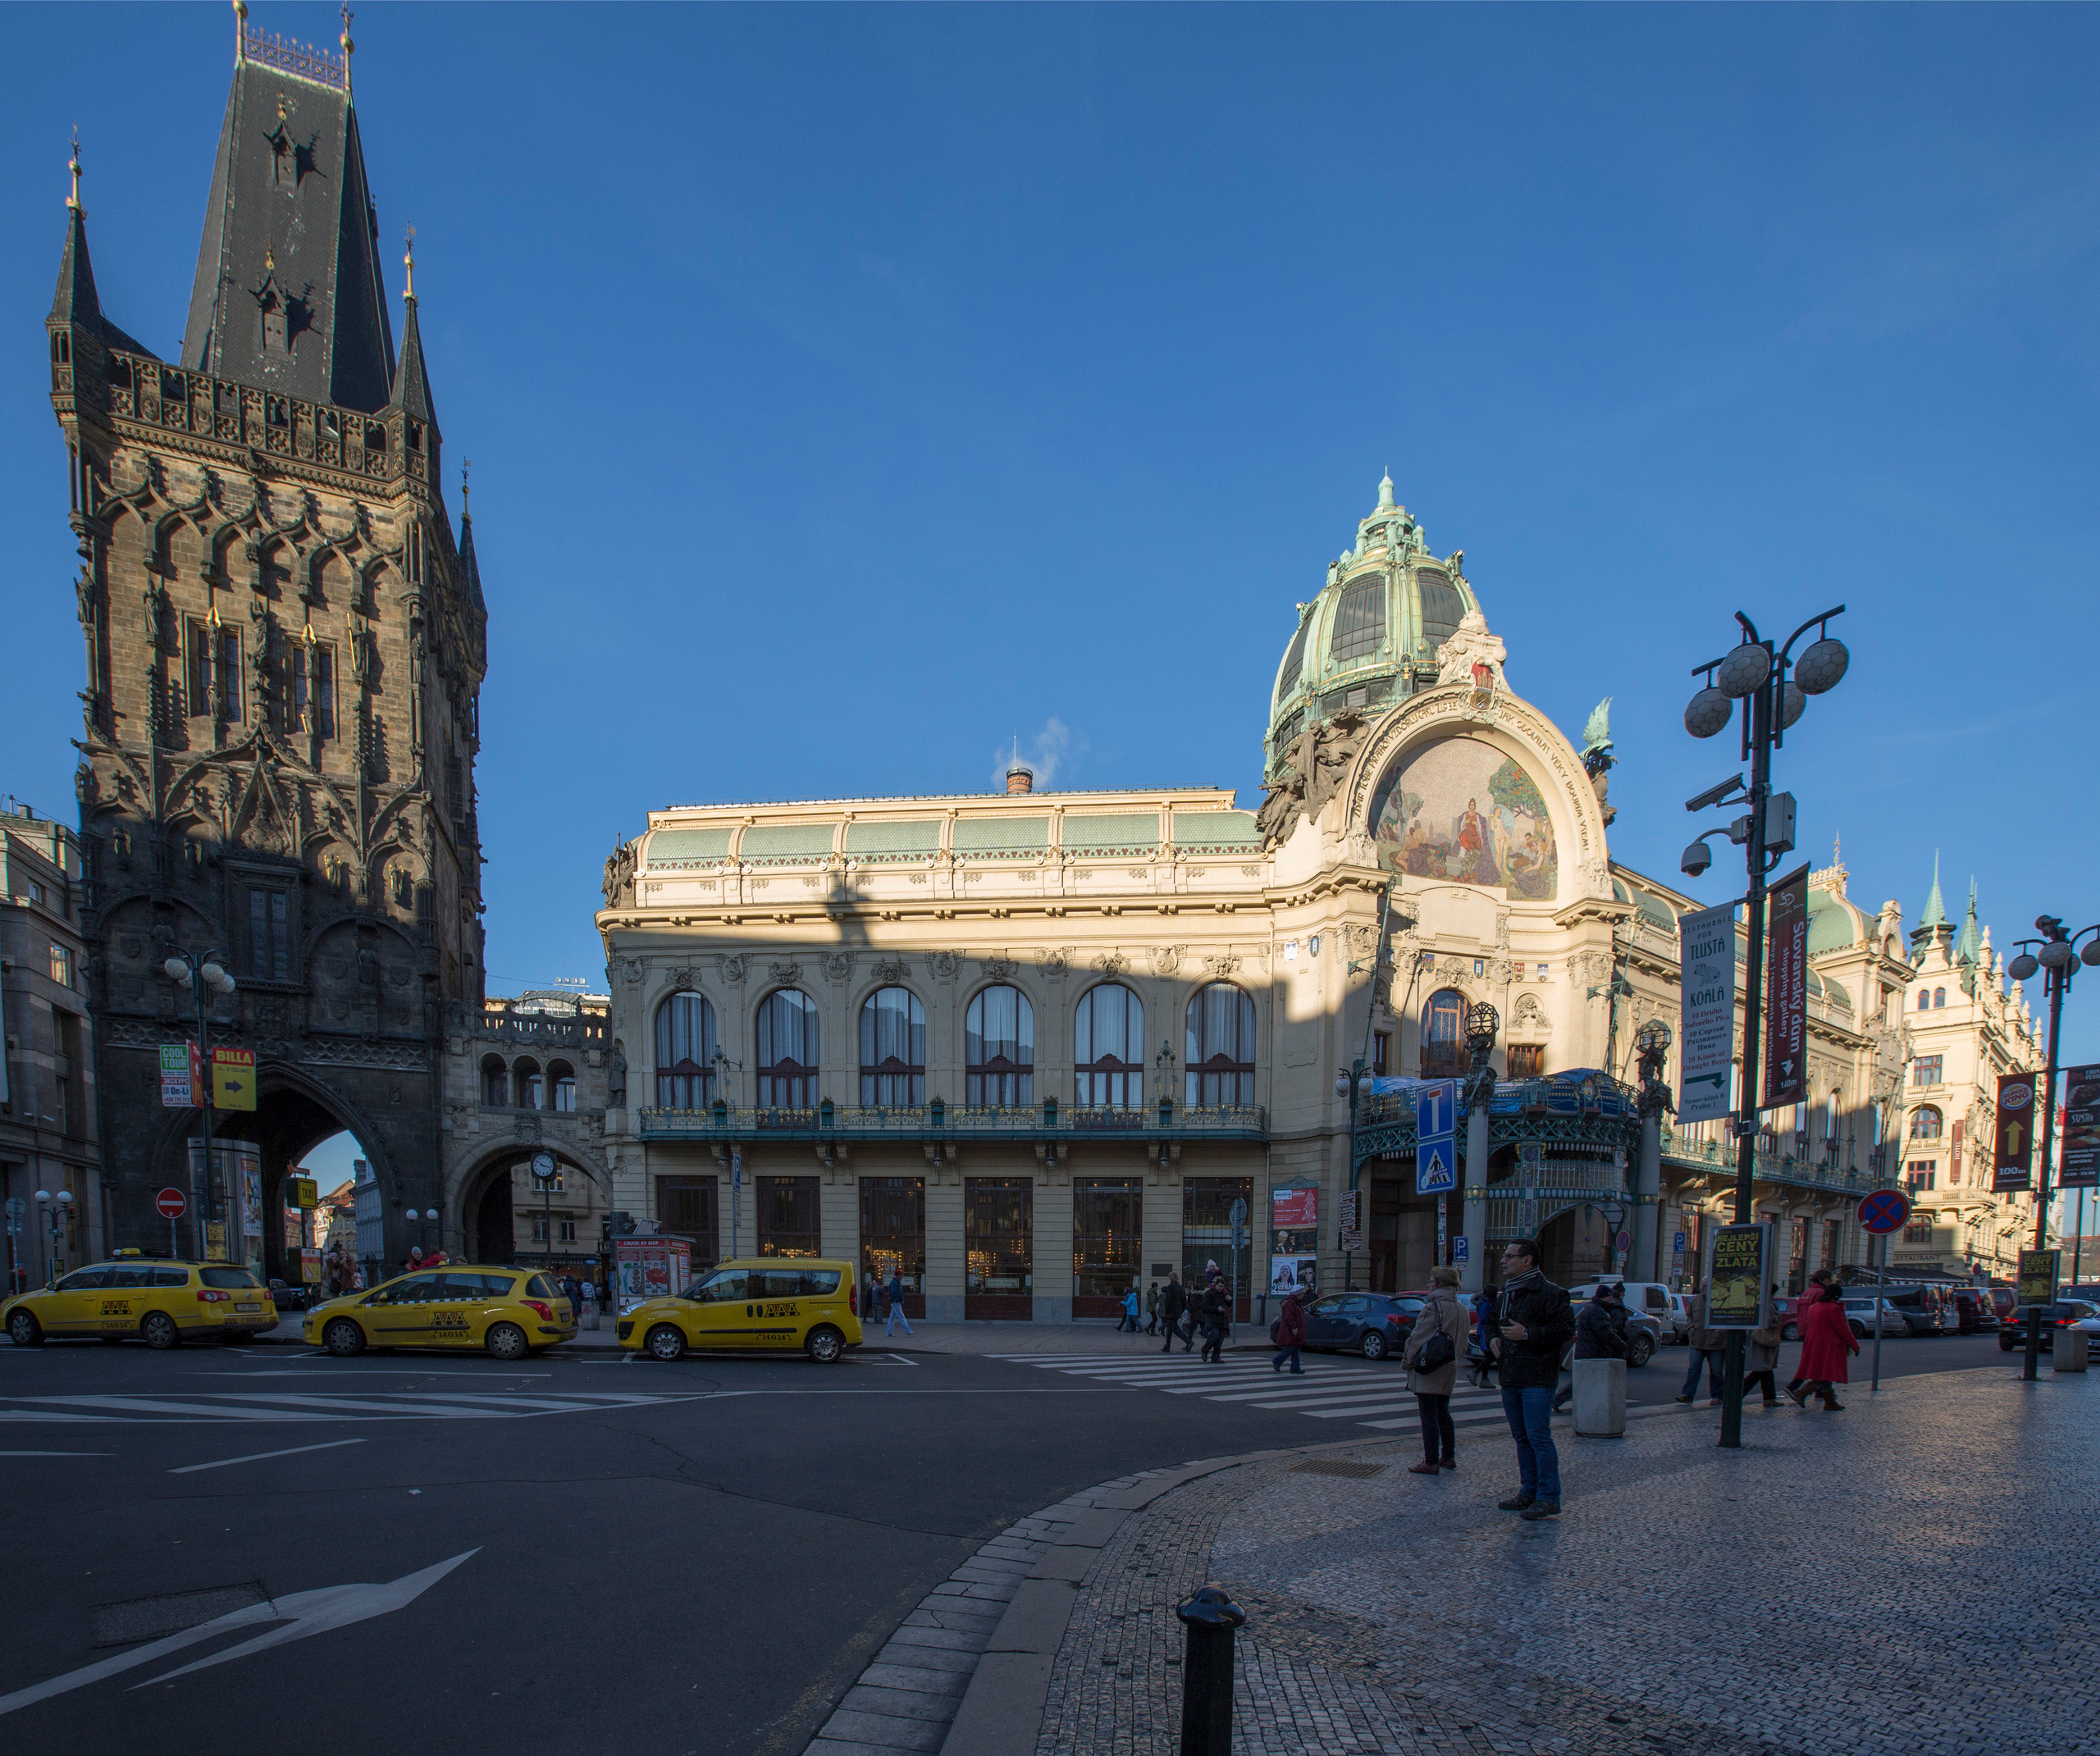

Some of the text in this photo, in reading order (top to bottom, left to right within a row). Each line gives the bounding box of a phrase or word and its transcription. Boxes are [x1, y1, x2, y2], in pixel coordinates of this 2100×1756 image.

[1682, 915, 1732, 935] RESTAURACE
[1697, 930, 1712, 939] PUB
[1690, 935, 1725, 960] TLUSTÁ
[1779, 946, 1790, 1038] shopping gallery
[1789, 921, 1805, 1054] Slovanský dům
[1690, 987, 1725, 1008] KOALA
[1684, 1019, 1714, 1029] Točeného
[1687, 1033, 1727, 1046] Разливного
[162, 1047, 186, 1058] COOL
[216, 1050, 253, 1064] BILLA
[1697, 1052, 1717, 1061] Kinds
[163, 1058, 187, 1068] TOUR
[1682, 1058, 1730, 1071] Draught Beers
[1780, 1079, 1797, 1089] 140m
[2003, 1087, 2028, 1099] BURGER
[2003, 1092, 2029, 1106] KING
[1691, 1102, 1710, 1111] Praha
[1998, 1166, 2027, 1175] 100m
[302, 1188, 314, 1201] TAXI
[1717, 1232, 1759, 1242] NEJLEPŠÍ
[1716, 1240, 1759, 1252] CENY
[1715, 1257, 1758, 1267] ZLATA
[100, 1300, 132, 1315] AAA
[765, 1302, 800, 1318] AAA
[431, 1311, 468, 1326] AAA
